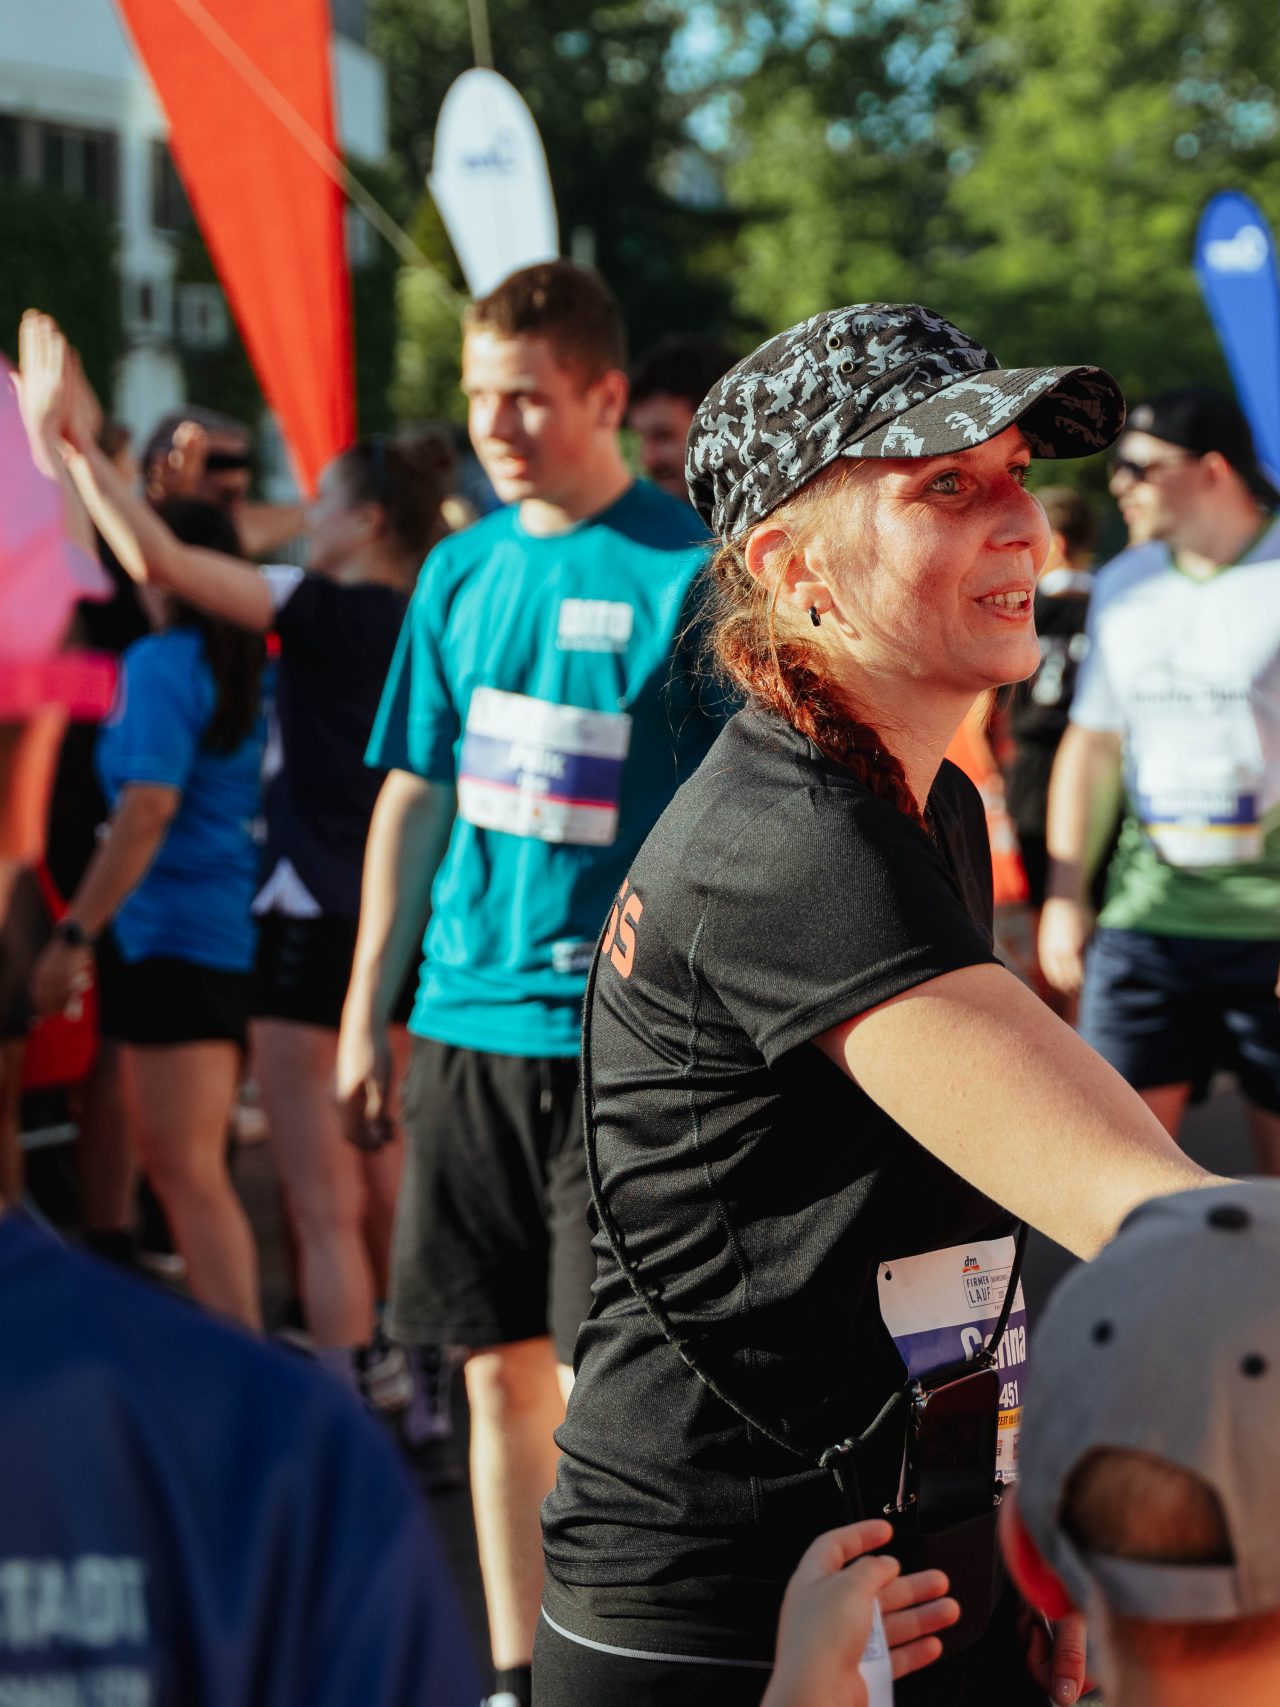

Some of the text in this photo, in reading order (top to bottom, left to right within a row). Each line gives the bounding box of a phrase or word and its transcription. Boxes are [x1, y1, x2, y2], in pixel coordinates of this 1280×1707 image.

[964, 1256, 977, 1267] dm
[966, 1276, 989, 1288] FIRMEN
[968, 1287, 990, 1303] LAUF
